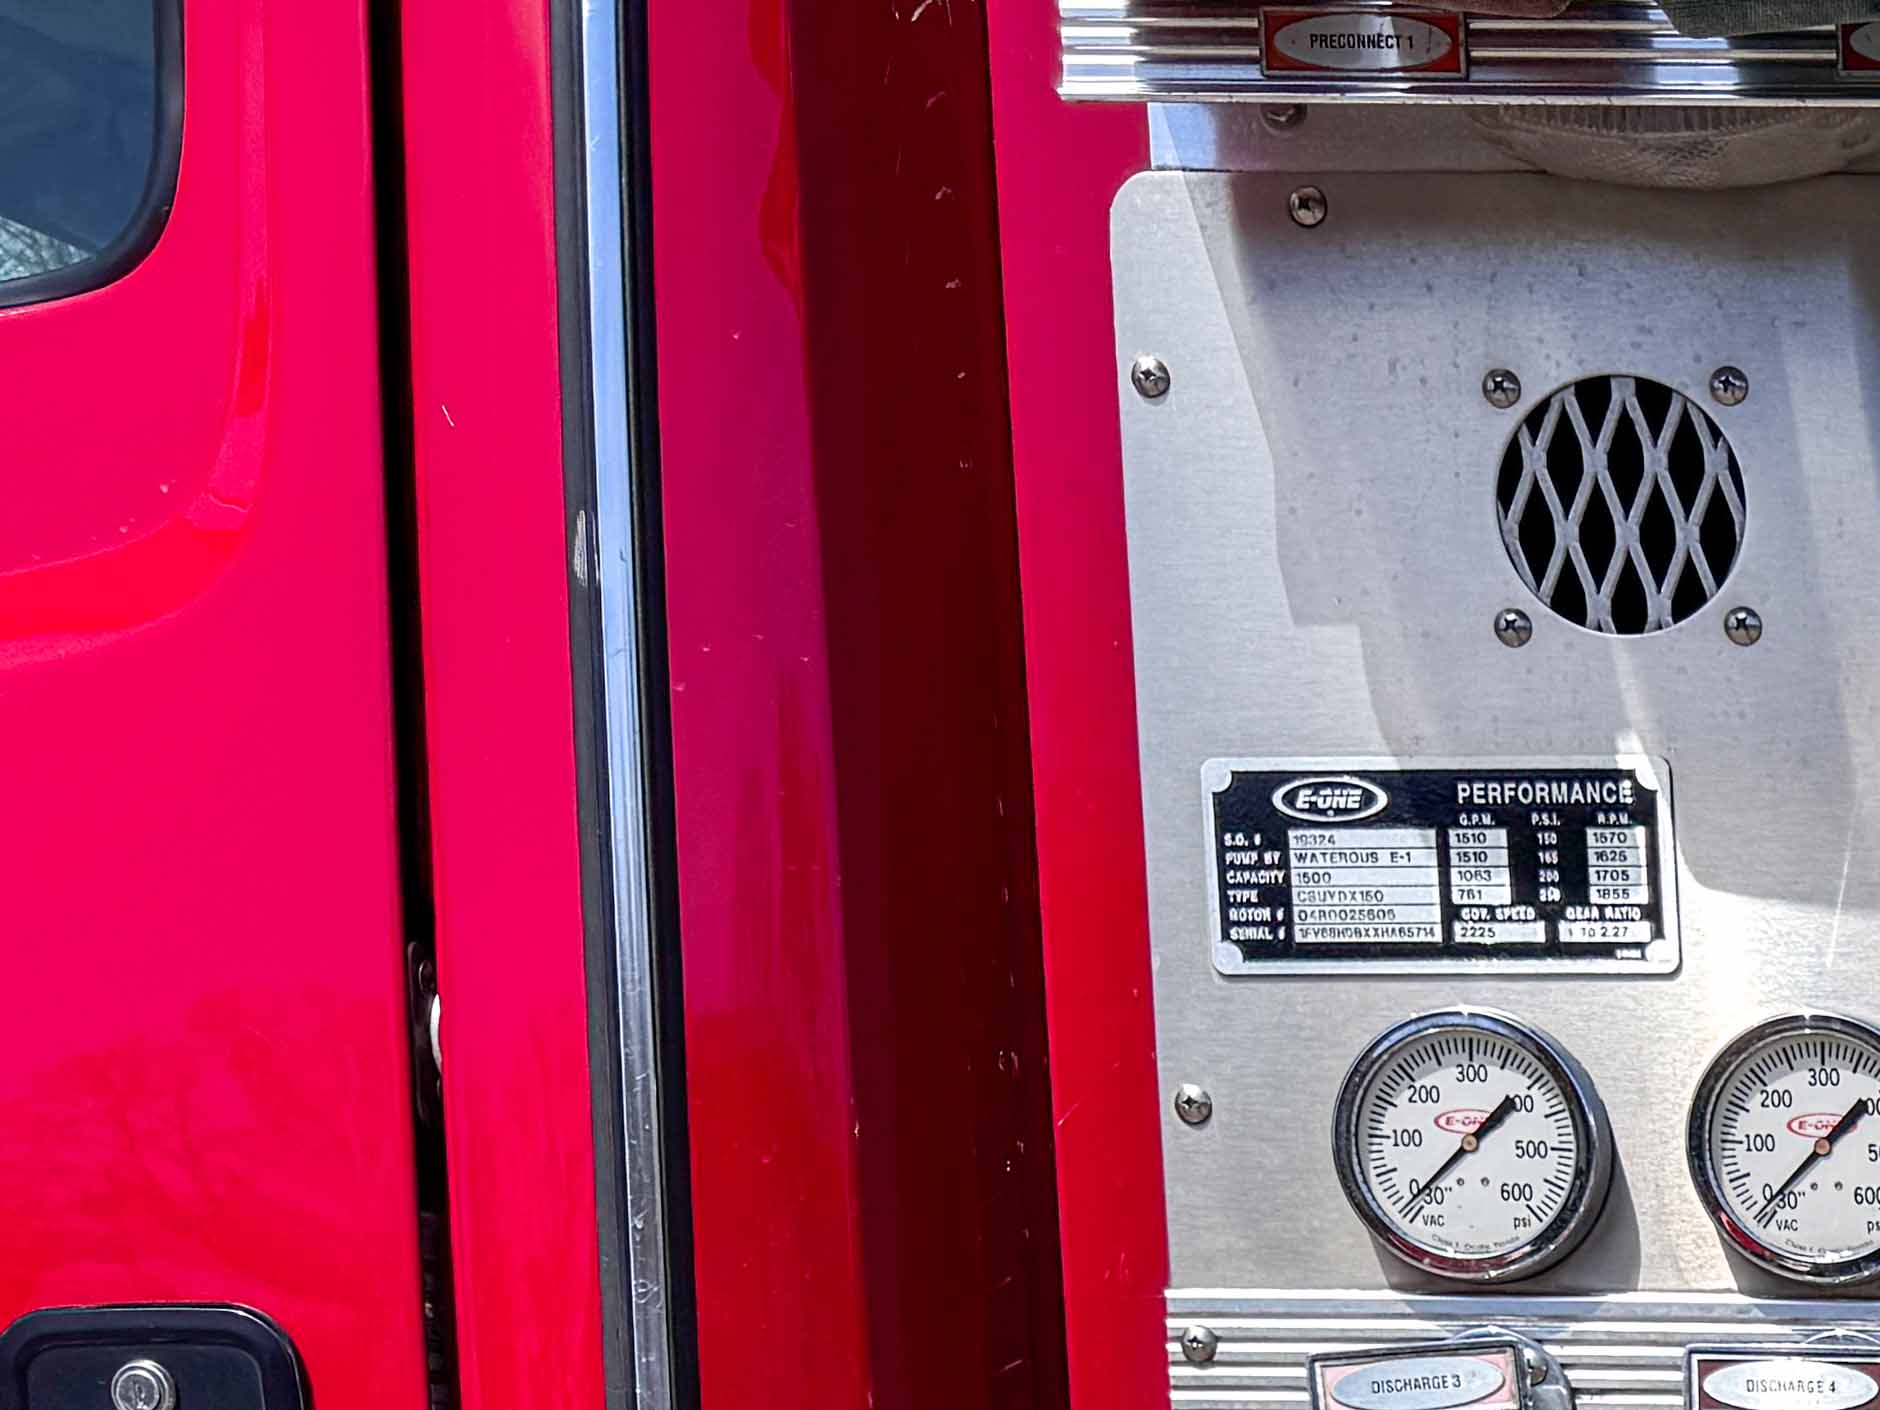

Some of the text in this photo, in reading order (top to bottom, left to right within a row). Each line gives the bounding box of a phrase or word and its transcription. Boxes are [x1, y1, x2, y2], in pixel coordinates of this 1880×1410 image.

[1309, 33, 1415, 49] PRECONNECT 1
[1296, 787, 1363, 811] E-ONE
[1456, 780, 1635, 805] PERFORMANCE
[1455, 832, 1487, 845] 1510
[1293, 851, 1379, 864] WATEROUS
[1456, 851, 1488, 863] 1510
[1226, 870, 1287, 885] CAPACITY
[1296, 872, 1331, 884] 1500
[1595, 869, 1630, 881] 1705
[1596, 888, 1631, 900] 1855
[1460, 926, 1496, 938] 2225
[1455, 1063, 1488, 1083] 300
[1807, 1067, 1841, 1087] 300
[1514, 1140, 1548, 1159] 500
[1371, 1373, 1461, 1394] DISCHARGE 3
[1745, 1379, 1837, 1393] DISCHARGE 4
